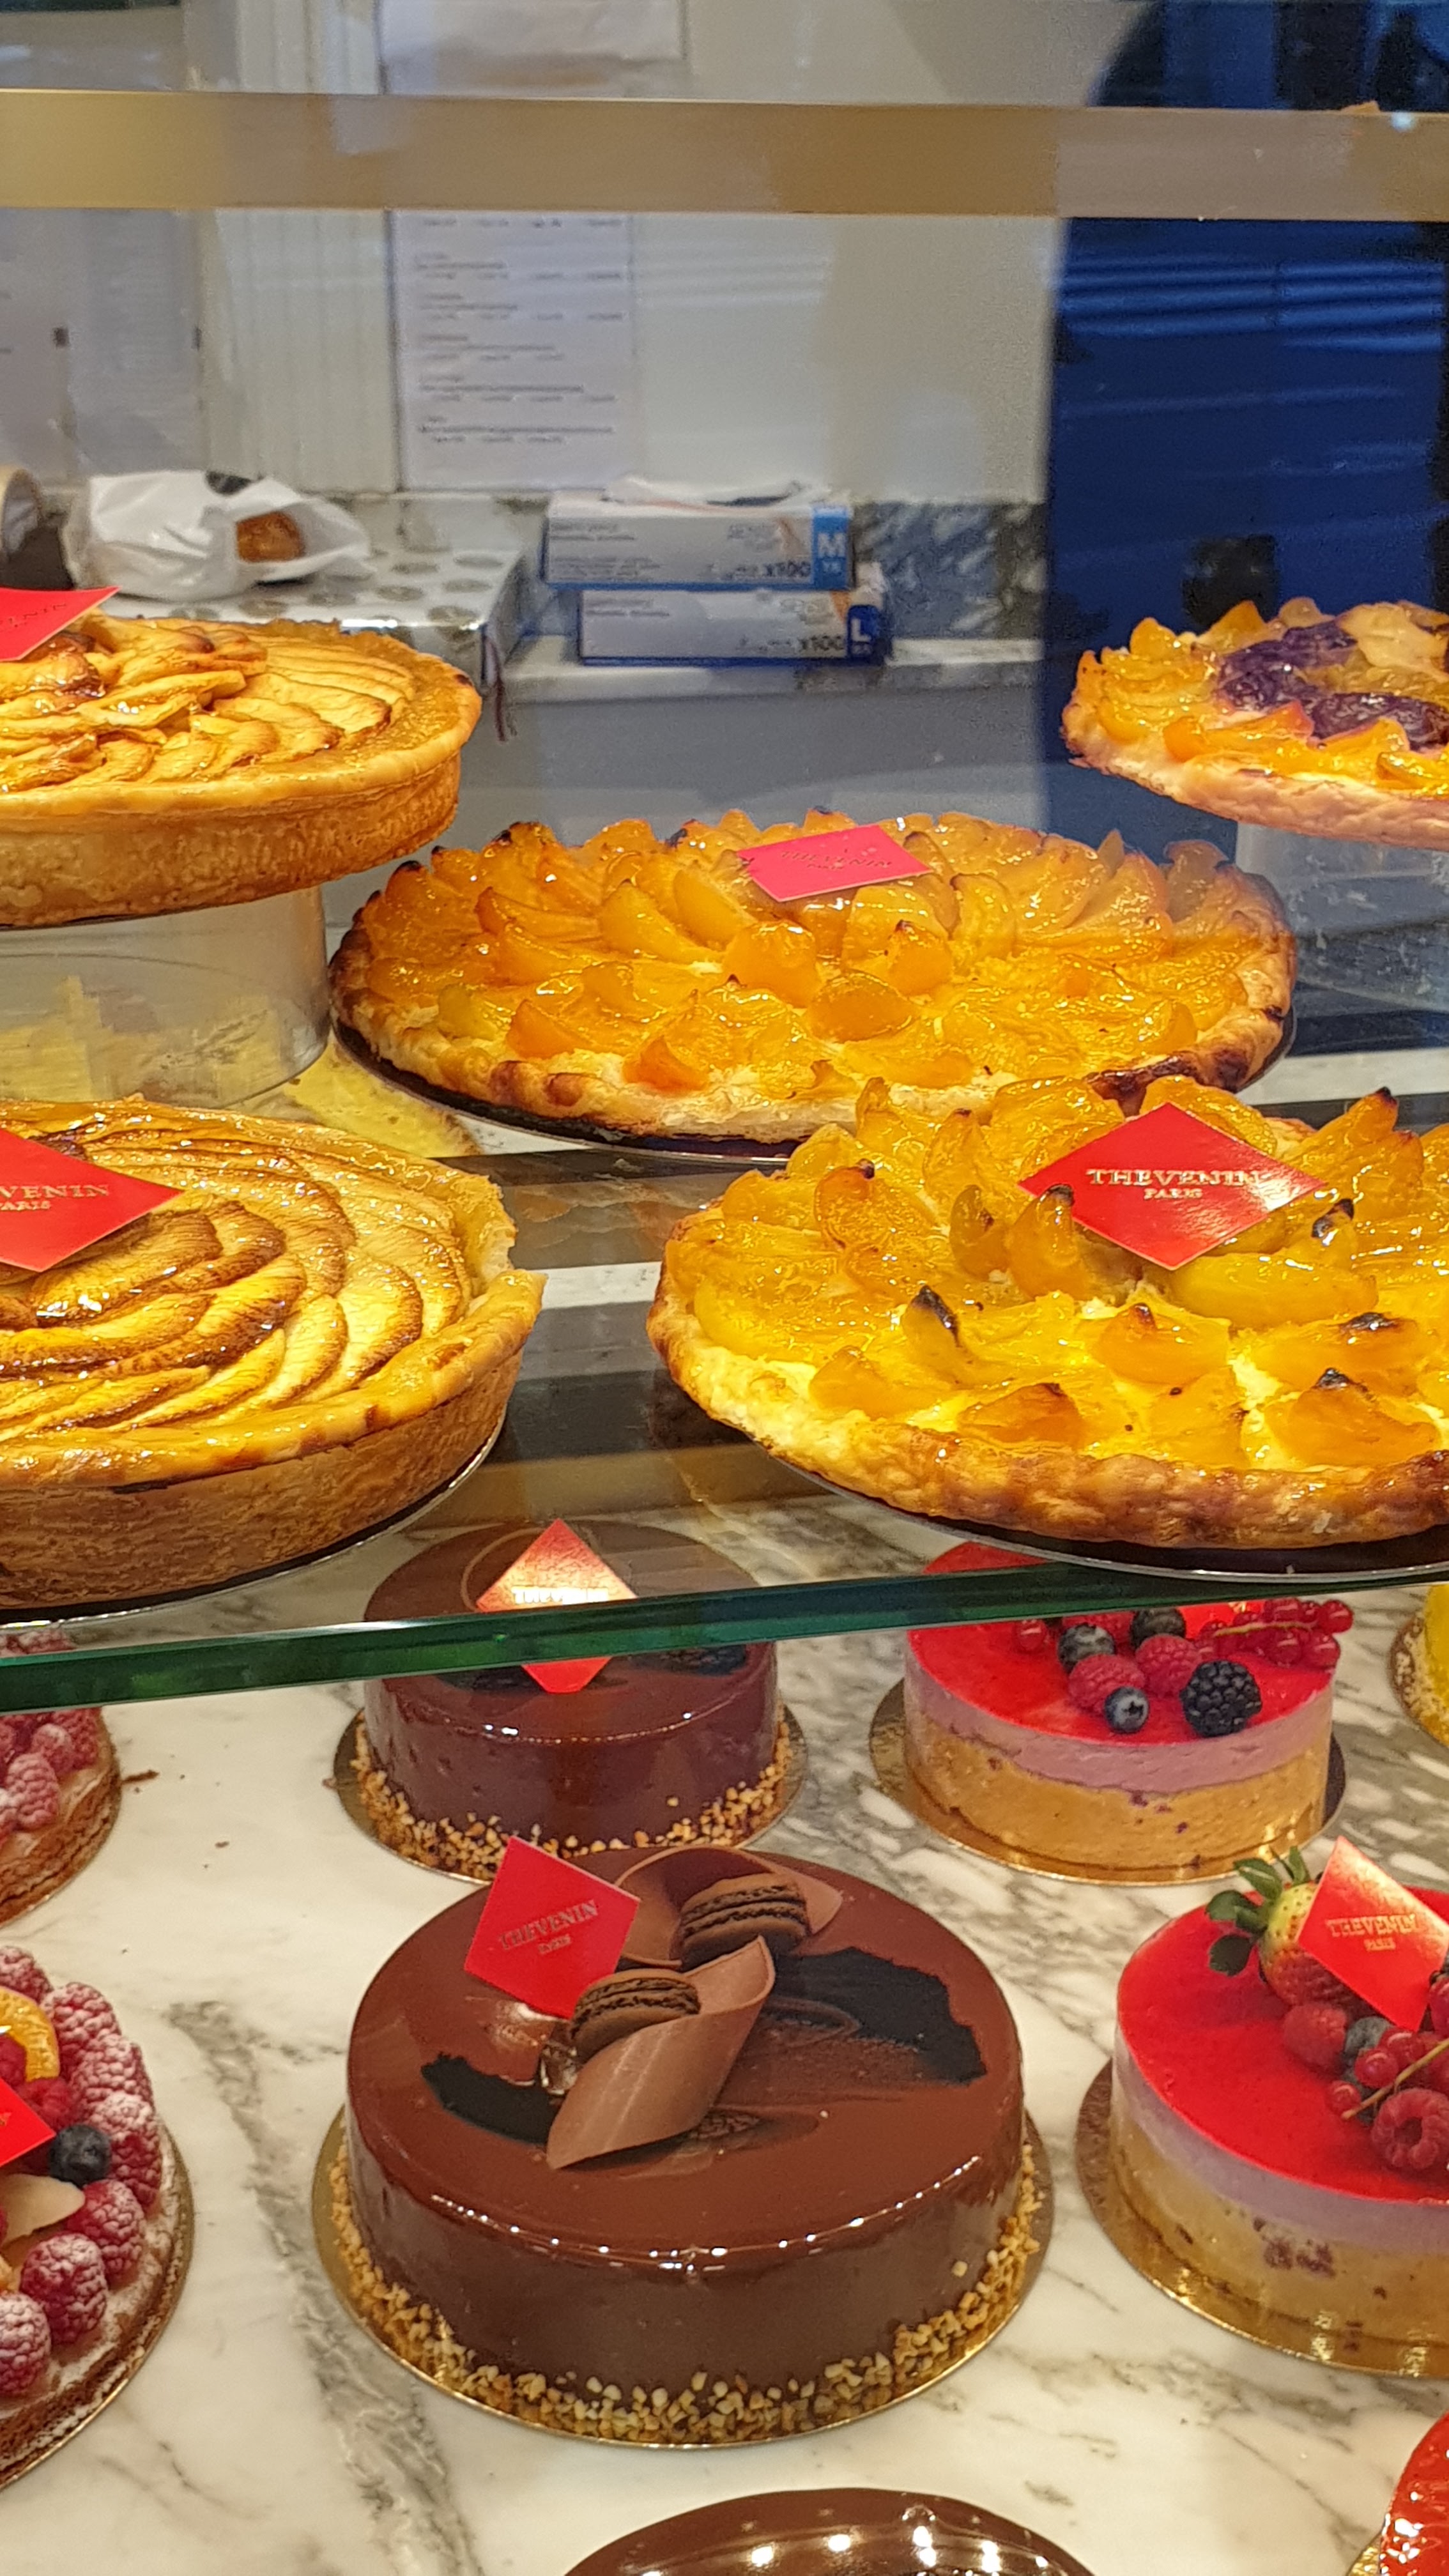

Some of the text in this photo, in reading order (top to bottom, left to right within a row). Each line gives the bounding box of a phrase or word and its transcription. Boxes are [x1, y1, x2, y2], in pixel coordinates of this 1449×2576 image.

[817, 533, 847, 558] M
[850, 618, 873, 642] L
[1086, 1169, 1262, 1186] THEVENIN
[1144, 1188, 1203, 1200] PARIS
[0, 1200, 52, 1211] ARIS
